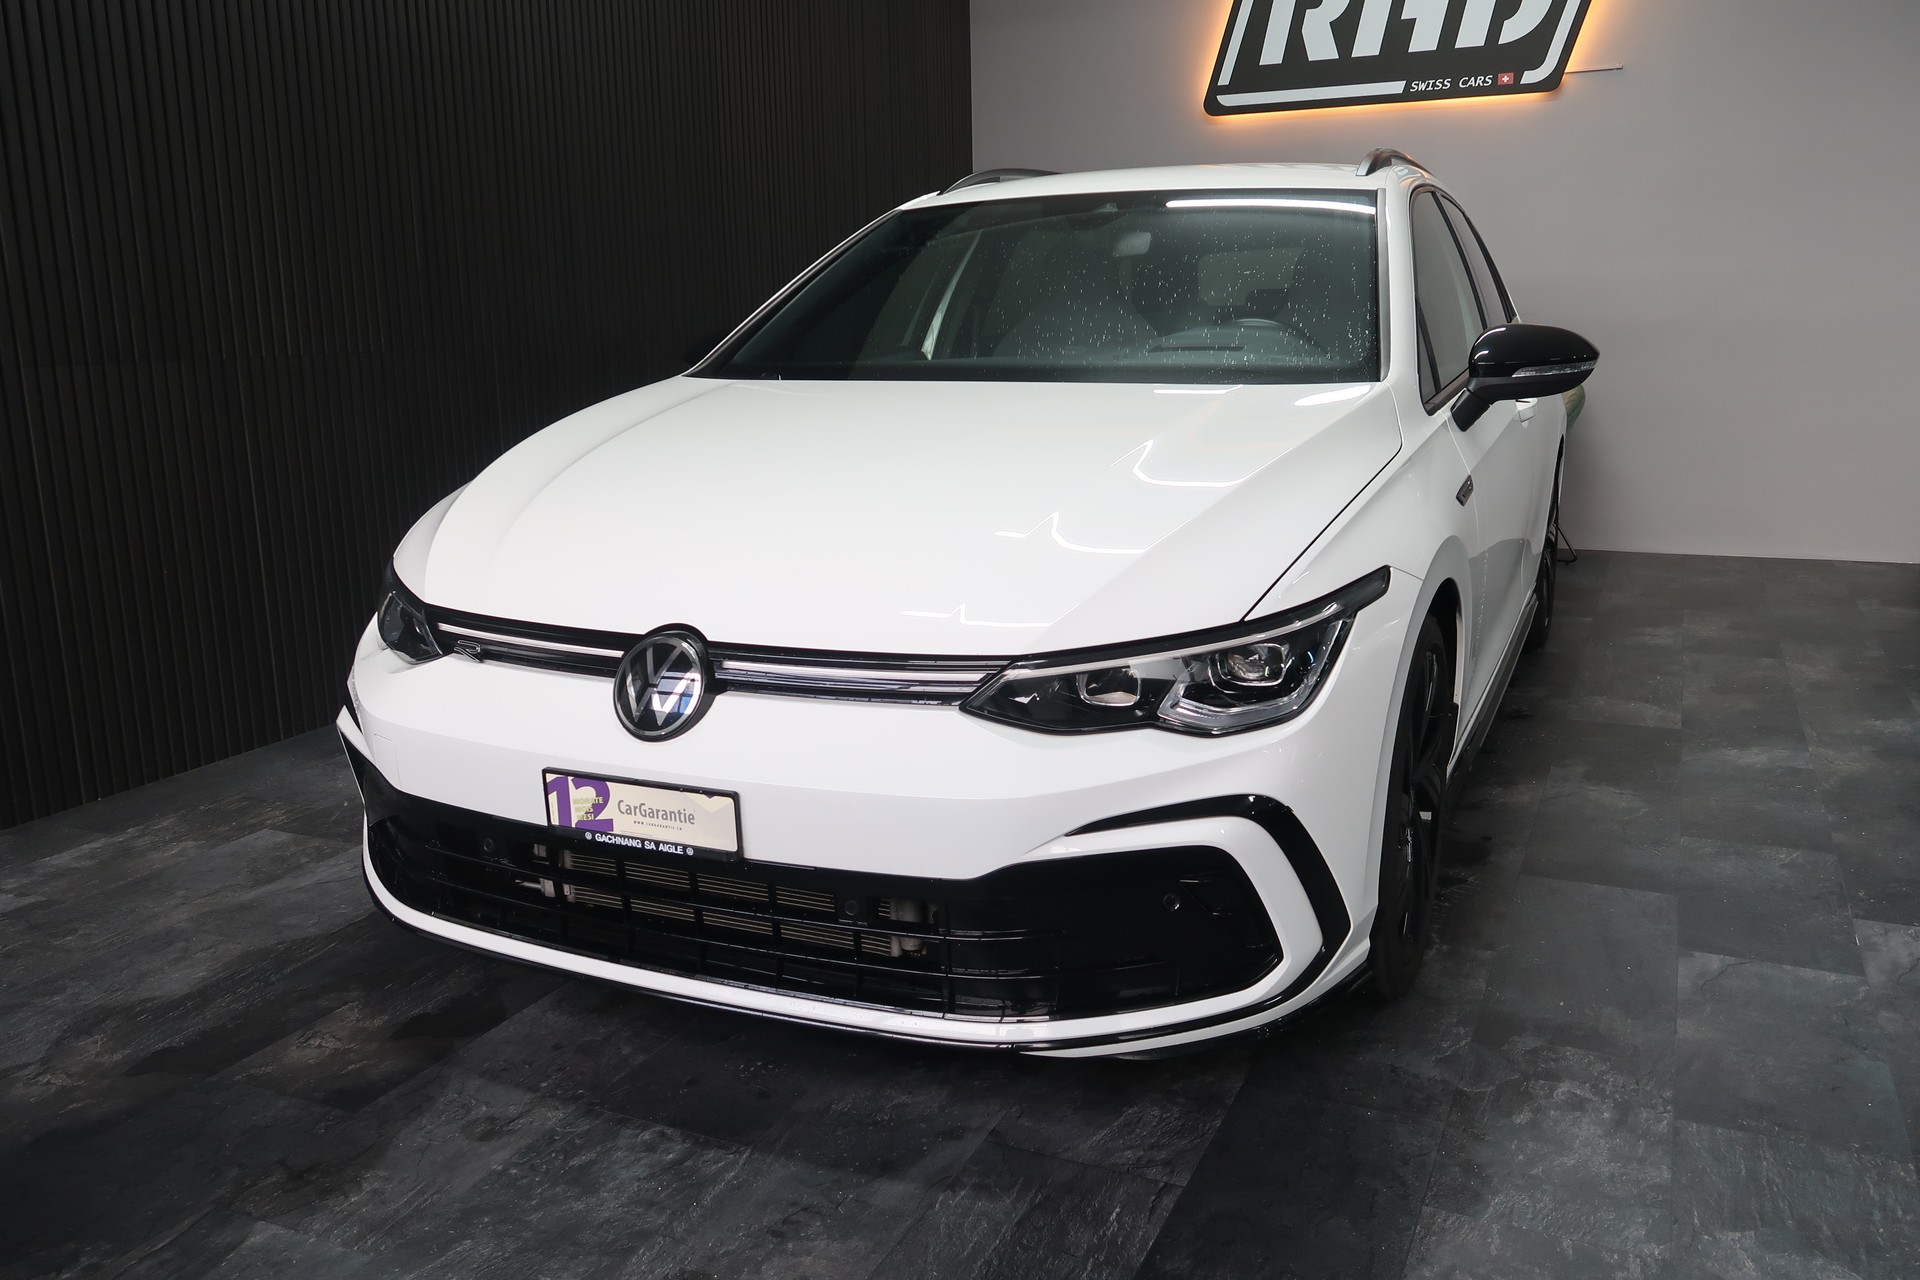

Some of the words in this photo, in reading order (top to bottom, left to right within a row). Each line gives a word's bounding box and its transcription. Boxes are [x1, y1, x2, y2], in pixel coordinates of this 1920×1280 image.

[1409, 78, 1451, 92] SWISS
[1458, 74, 1493, 88] CARS
[546, 775, 614, 832] 12
[617, 799, 696, 825] CarGarantie
[595, 833, 642, 848] GACHNANG
[644, 840, 656, 850] SA
[658, 844, 684, 855] AIGLE
